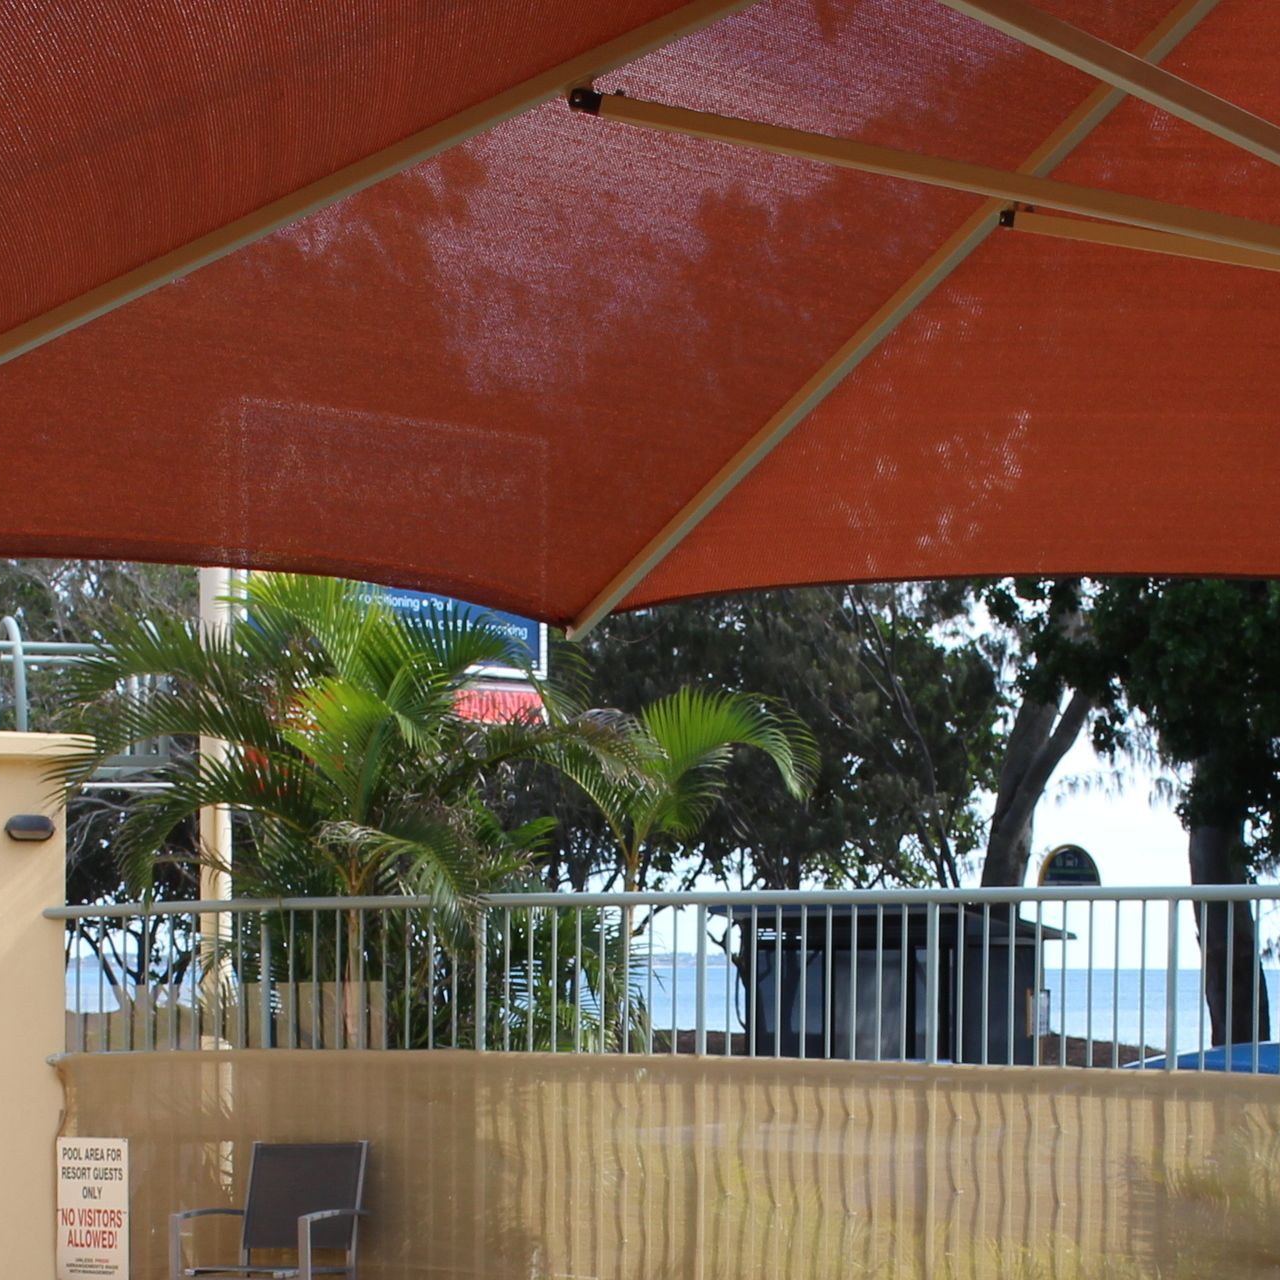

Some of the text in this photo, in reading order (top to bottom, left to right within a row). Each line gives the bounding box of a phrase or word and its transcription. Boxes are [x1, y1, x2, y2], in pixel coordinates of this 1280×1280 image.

[62, 1147, 122, 1162] POOL AREA FOR
[61, 1166, 123, 1181] RESORT GUESTS
[82, 1186, 103, 1200] ONLY
[61, 1208, 122, 1228] NO VISITORS
[67, 1229, 118, 1250] ALLOWED!
